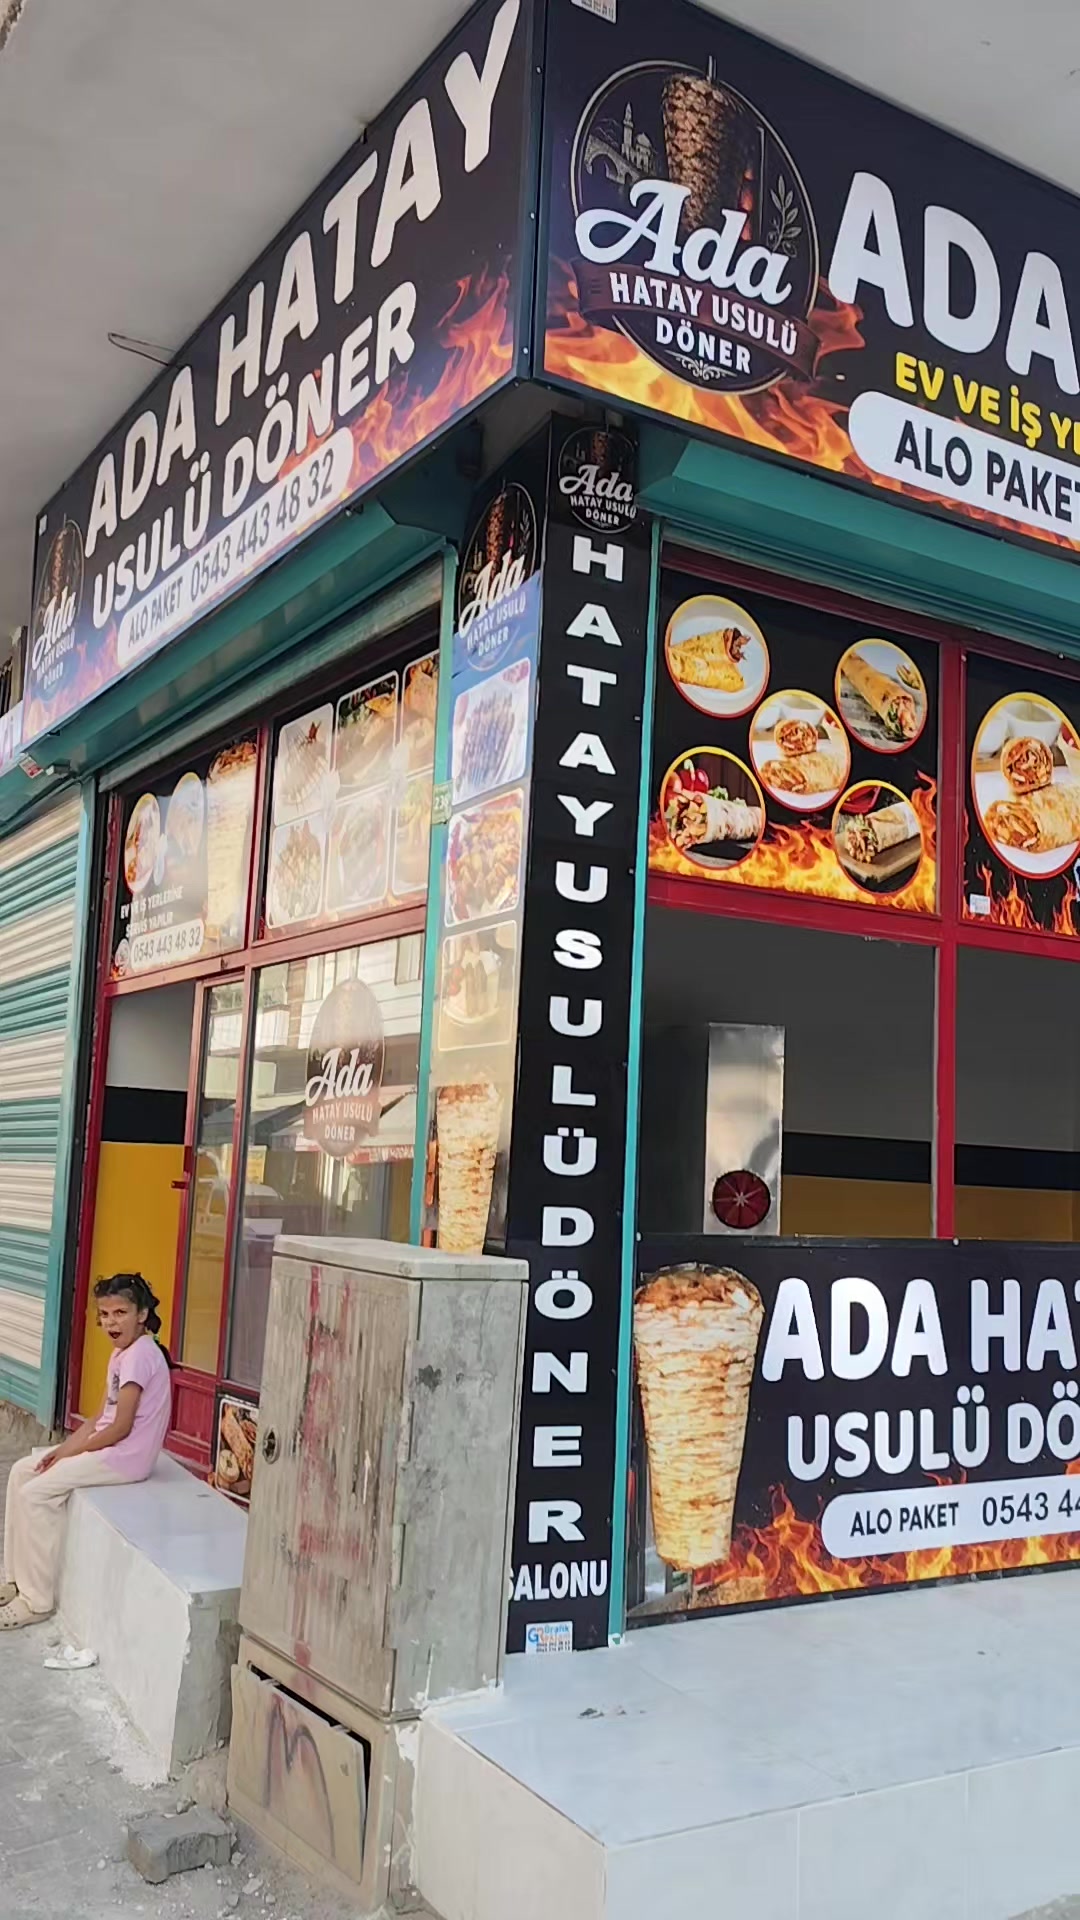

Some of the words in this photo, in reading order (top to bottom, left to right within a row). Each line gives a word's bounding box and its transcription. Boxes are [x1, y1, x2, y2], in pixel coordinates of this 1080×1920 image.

[85, 364, 197, 558] ADA
[215, 0, 521, 427] HATAY
[575, 179, 792, 305] Ada
[827, 171, 1080, 395] ADA
[609, 272, 702, 317] HATAY
[712, 294, 797, 355] USULÜ
[656, 316, 750, 374] DÖNER
[895, 351, 944, 401] EV
[952, 374, 1001, 424] VE
[1010, 384, 1042, 448] İŞ
[93, 450, 212, 629] USULÜ
[222, 281, 417, 518] DÖNER
[559, 464, 634, 502] Ada
[894, 419, 973, 486] ALO
[570, 495, 602, 509] HATAY
[128, 606, 148, 648] ALO
[151, 576, 183, 631] PAKET
[190, 535, 232, 602] 0543
[236, 502, 271, 564] 443
[276, 475, 301, 532] 48
[307, 447, 334, 508] 32
[32, 585, 76, 671] Ada
[458, 549, 526, 638] Ada
[467, 612, 495, 651] HATAY
[557, 534, 624, 837] HATAY
[120, 903, 130, 919] EV
[133, 939, 154, 962] 0543
[156, 933, 173, 955] 443
[175, 929, 187, 950] 48
[188, 926, 201, 948] 32
[543, 861, 609, 1177] USULÜ
[305, 1047, 374, 1107] Ada
[312, 1102, 341, 1124] HATAY
[761, 1277, 949, 1382] ADA
[971, 1278, 1080, 1374] HA
[528, 1206, 595, 1543] DÖNER
[787, 1384, 990, 1481] USULÜ
[850, 1508, 893, 1538] ALO
[899, 1501, 959, 1533] PAKET
[981, 1491, 1049, 1527] 0543
